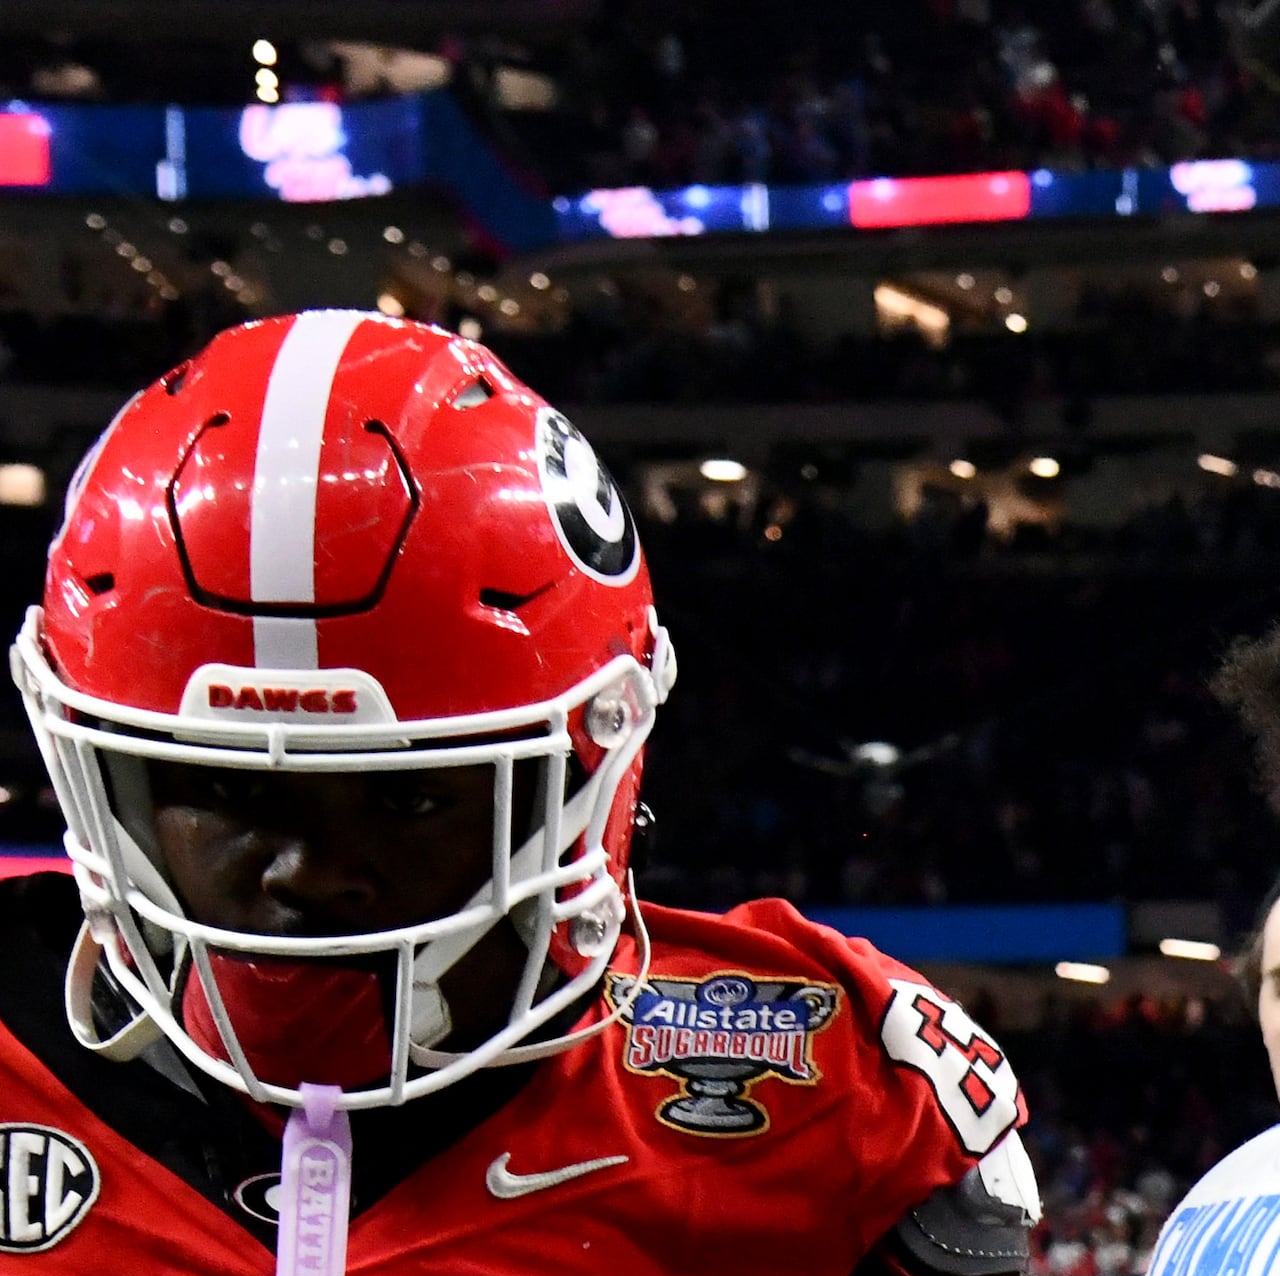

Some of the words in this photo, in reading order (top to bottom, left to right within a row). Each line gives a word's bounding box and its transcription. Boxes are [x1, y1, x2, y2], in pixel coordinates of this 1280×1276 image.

[208, 684, 358, 714] DAWGS
[642, 999, 803, 1032] Allstate
[0, 1131, 85, 1242] EC
